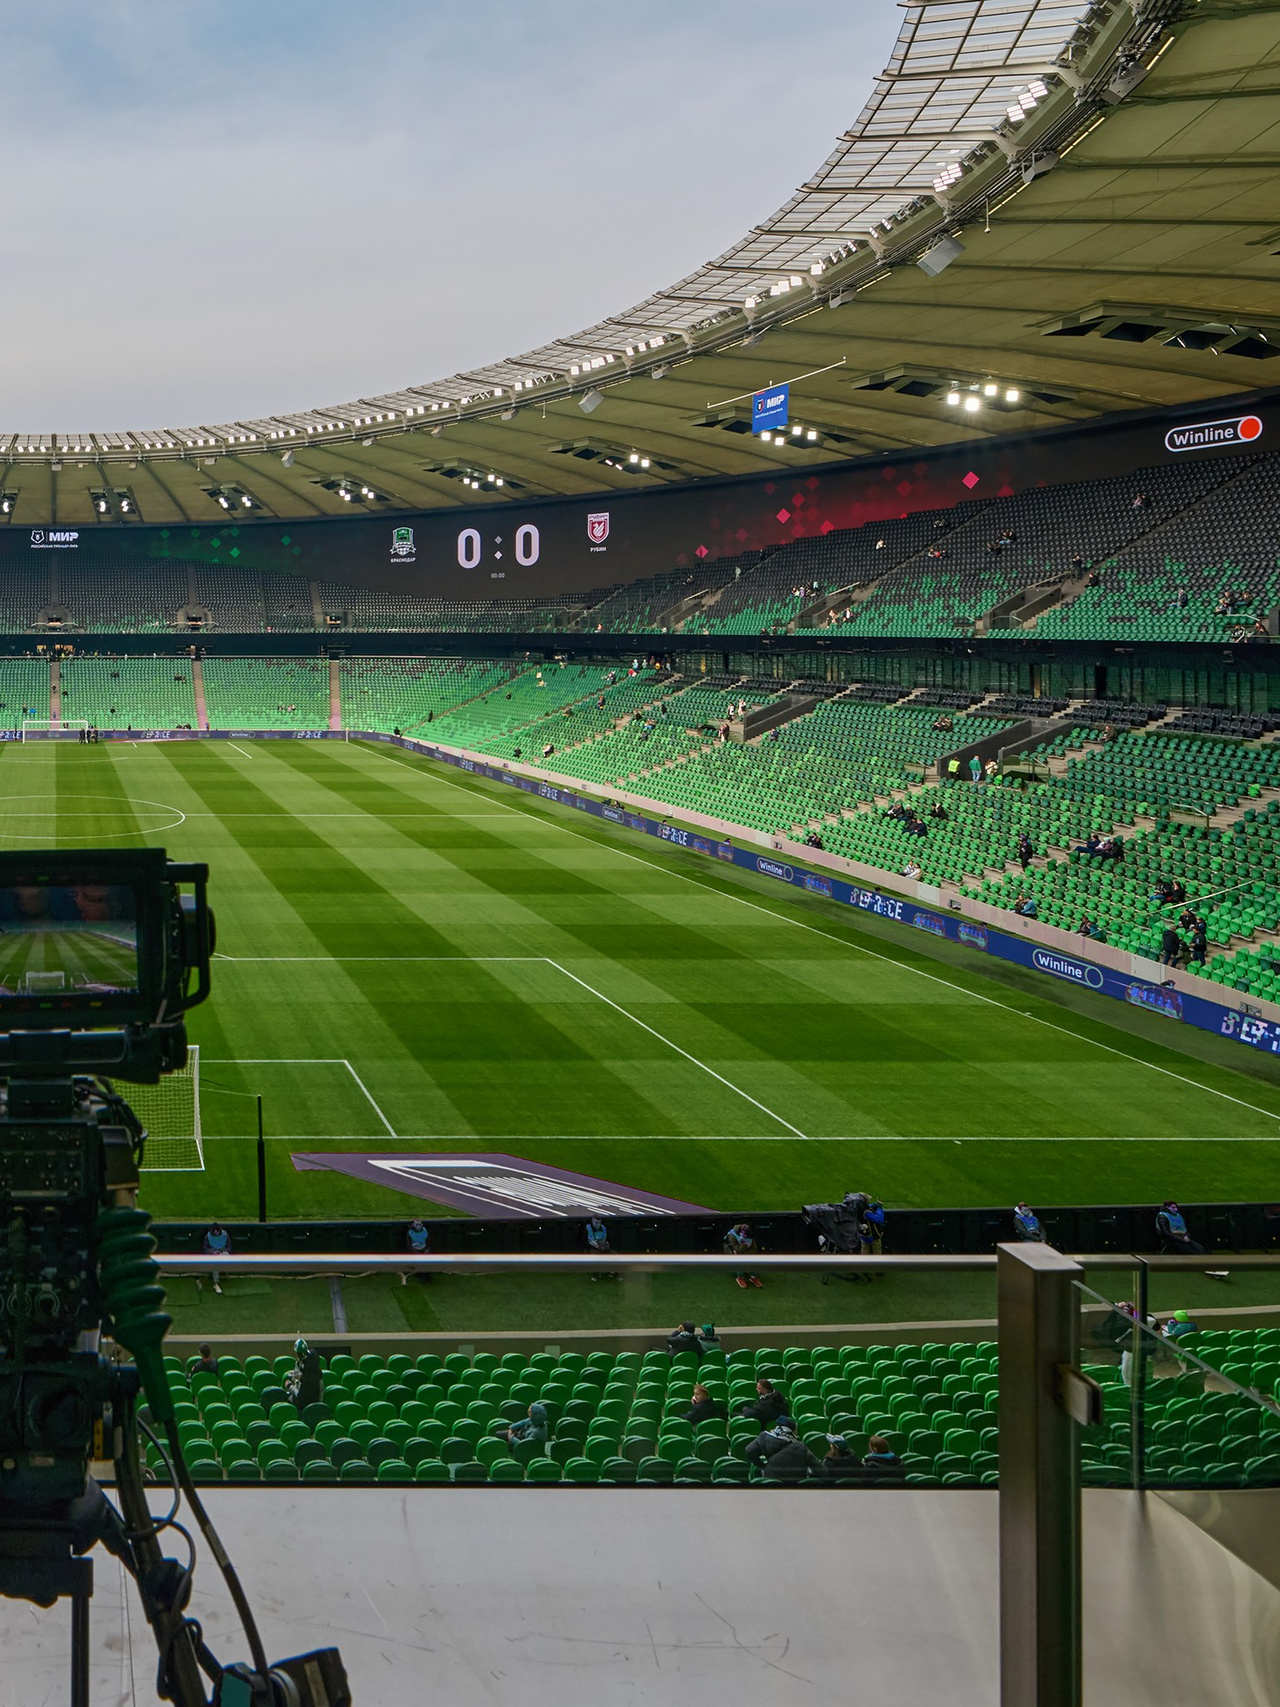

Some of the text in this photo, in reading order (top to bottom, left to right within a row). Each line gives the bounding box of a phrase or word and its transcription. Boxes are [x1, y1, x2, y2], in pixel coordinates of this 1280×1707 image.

[1173, 427, 1234, 446] Winline
[49, 532, 79, 541] МИР
[457, 528, 482, 569] 0
[515, 523, 540, 567] 0
[760, 860, 783, 876] Winline
[1038, 953, 1083, 978] Winline
